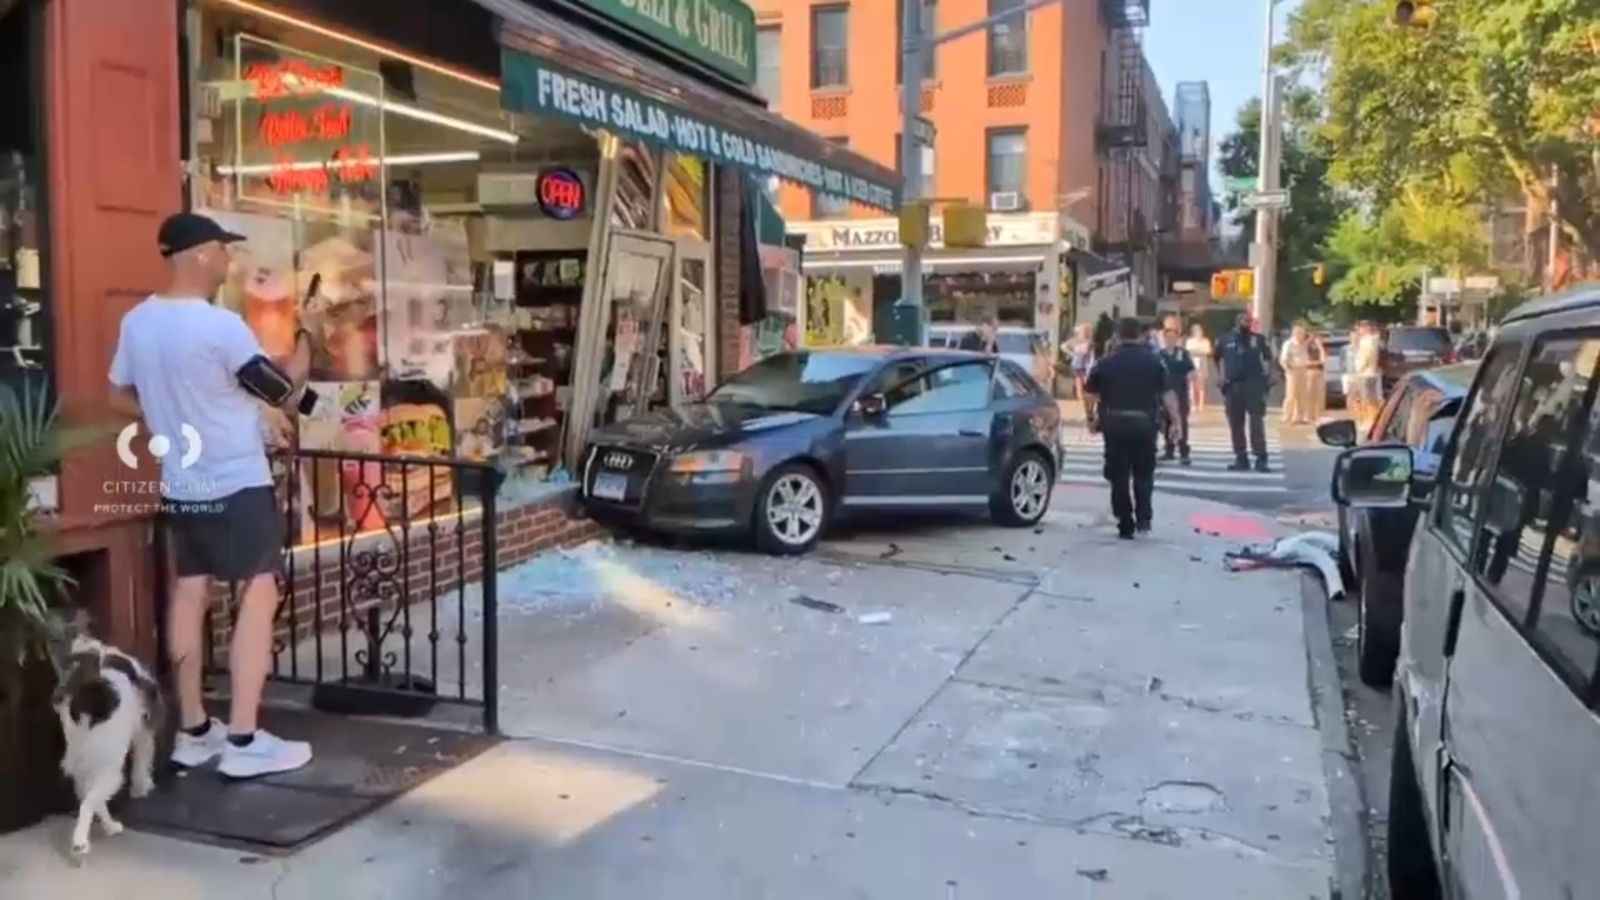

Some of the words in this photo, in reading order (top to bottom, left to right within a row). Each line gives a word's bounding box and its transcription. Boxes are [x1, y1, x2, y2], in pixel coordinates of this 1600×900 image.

[694, 0, 748, 68] GRILL
[537, 68, 608, 123] FRESH
[611, 93, 669, 139] SALAD
[709, 126, 721, 156] &
[722, 132, 756, 166] COLD
[541, 177, 581, 208] OPEN
[832, 225, 898, 246] MAZZO
